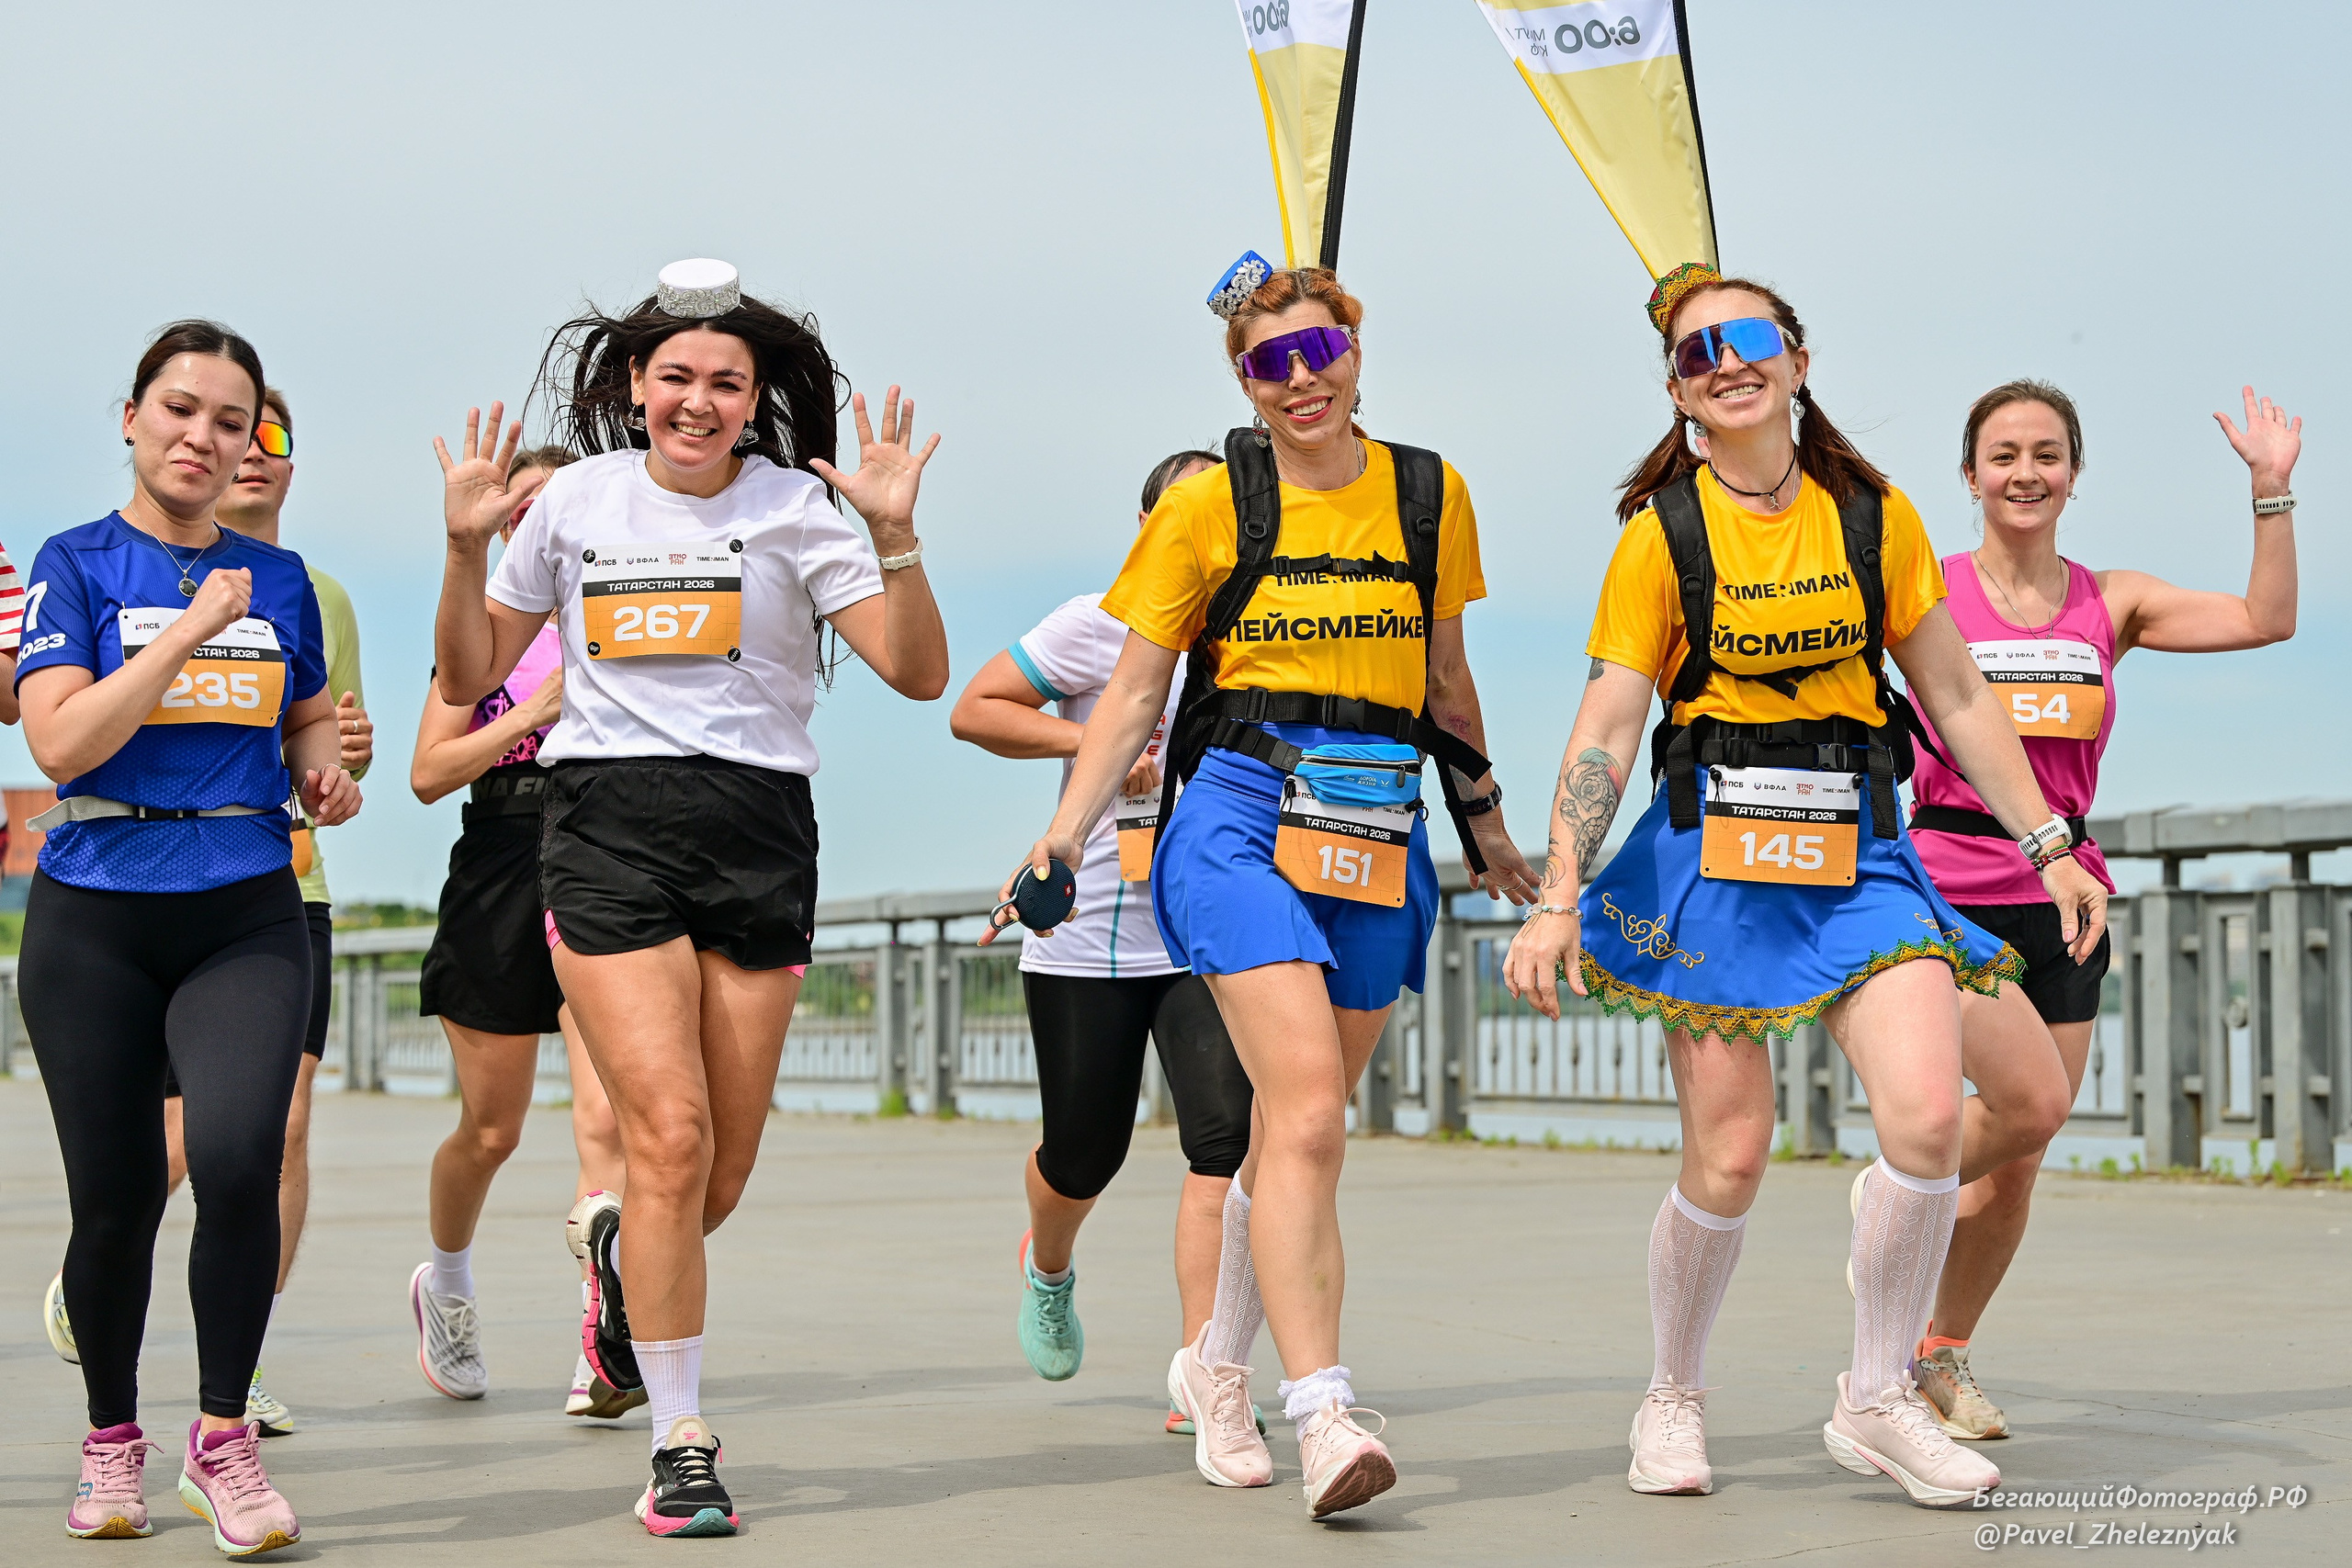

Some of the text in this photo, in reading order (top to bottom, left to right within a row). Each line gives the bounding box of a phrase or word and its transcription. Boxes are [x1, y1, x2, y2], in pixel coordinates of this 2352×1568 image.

[602, 558, 617, 567] ПСБ
[606, 580, 715, 592] ТАТАРСТАН 2026
[143, 622, 160, 630] ПСБ
[613, 604, 710, 642] 267
[194, 648, 260, 659] СТАН 2026
[1990, 672, 2084, 682] ТАТАРСТАН 2026
[162, 671, 261, 709] 235
[2011, 693, 2071, 724] 54
[1731, 805, 1837, 821] ТАТАРСТАН 2026
[1304, 817, 1391, 840] ТАТАРСТАН 2026
[1738, 831, 1825, 870] 145
[1317, 845, 1373, 887] 151
